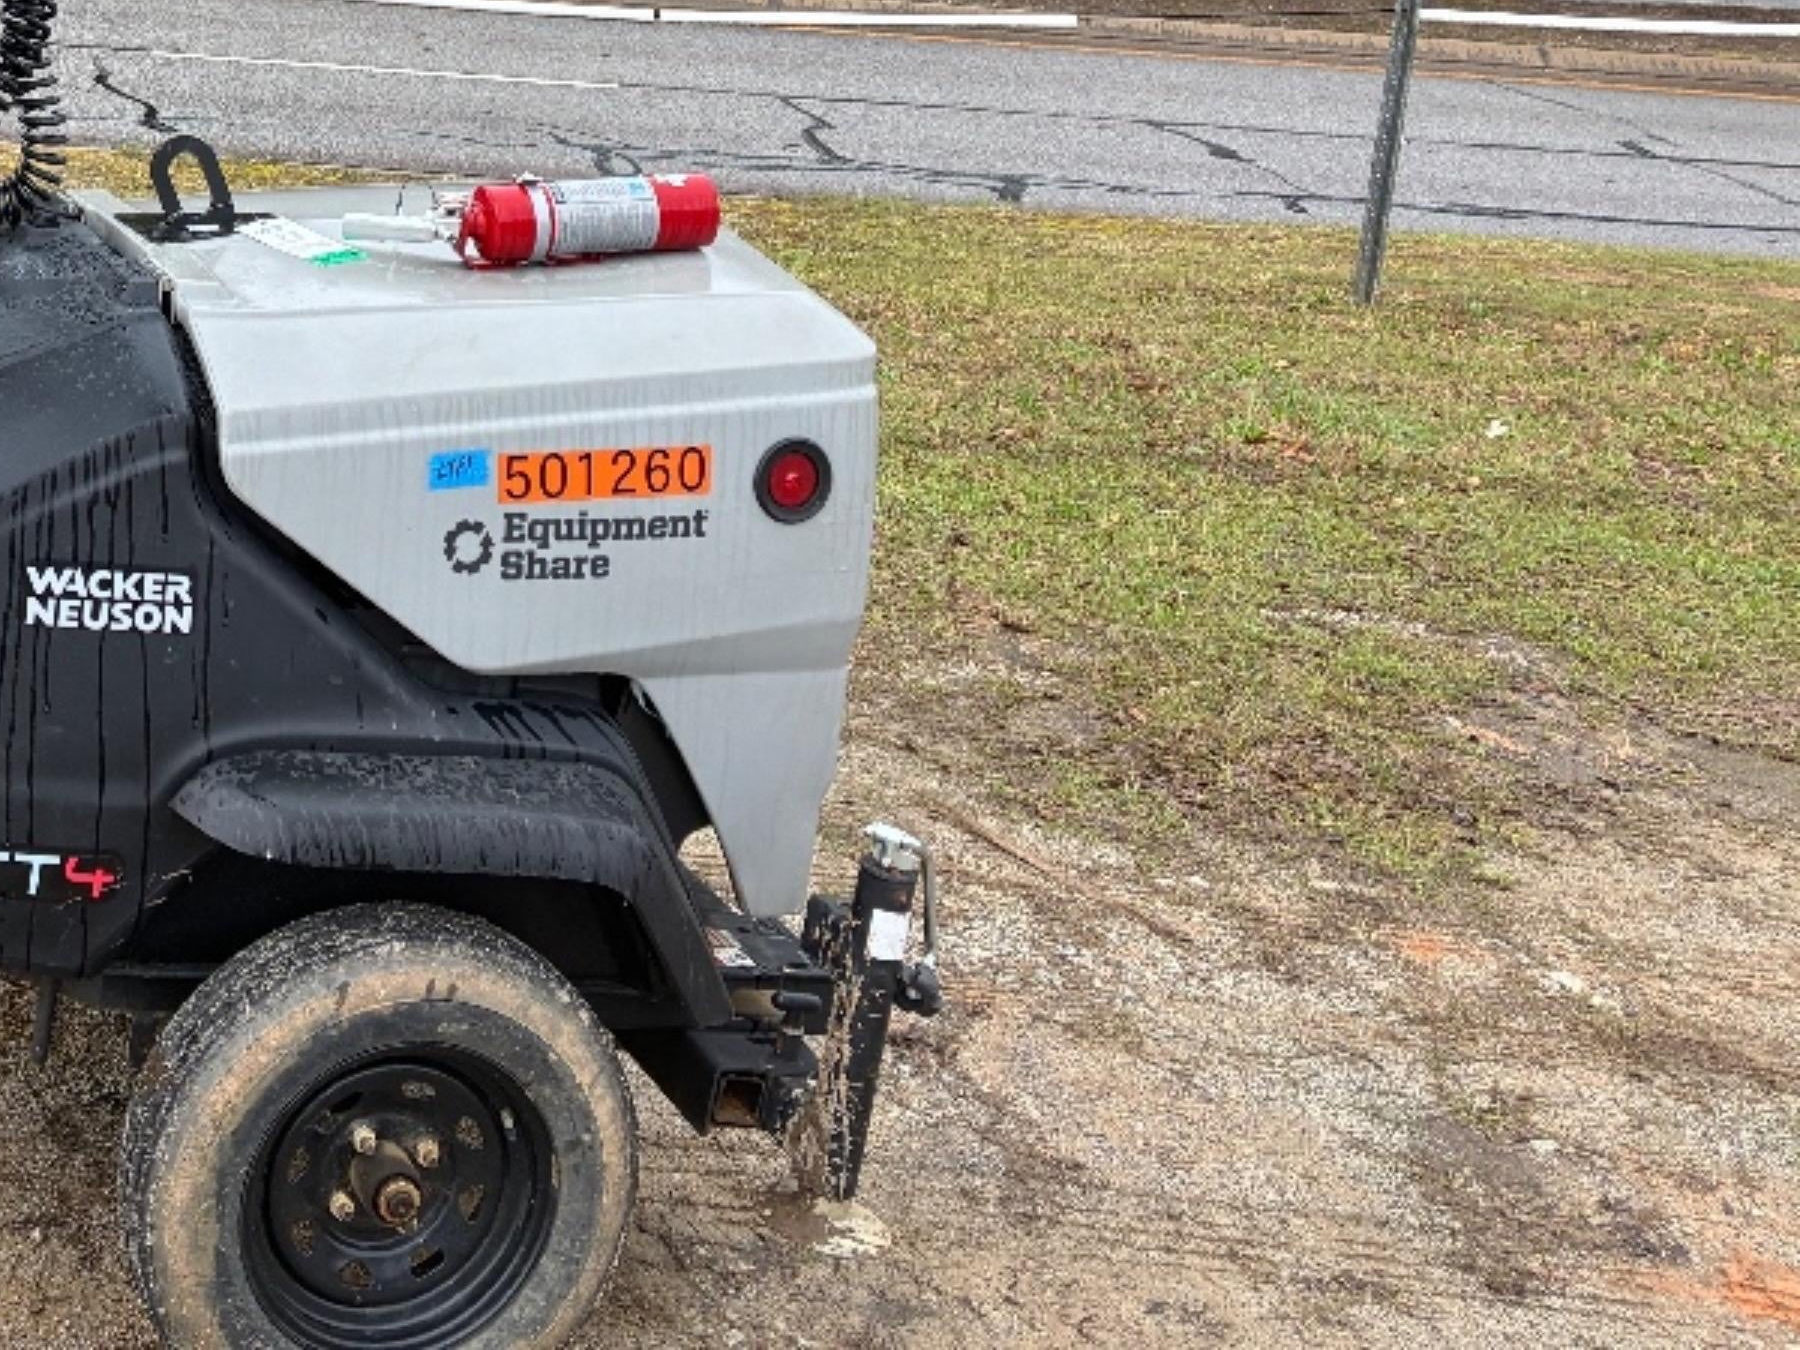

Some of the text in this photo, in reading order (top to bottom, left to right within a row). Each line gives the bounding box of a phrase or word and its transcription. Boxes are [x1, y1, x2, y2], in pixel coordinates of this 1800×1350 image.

[504, 447, 706, 499] 501260
[502, 510, 709, 548] Equipment
[25, 565, 193, 604] WACKER
[500, 550, 611, 581] Share
[24, 595, 193, 635] NEUSON
